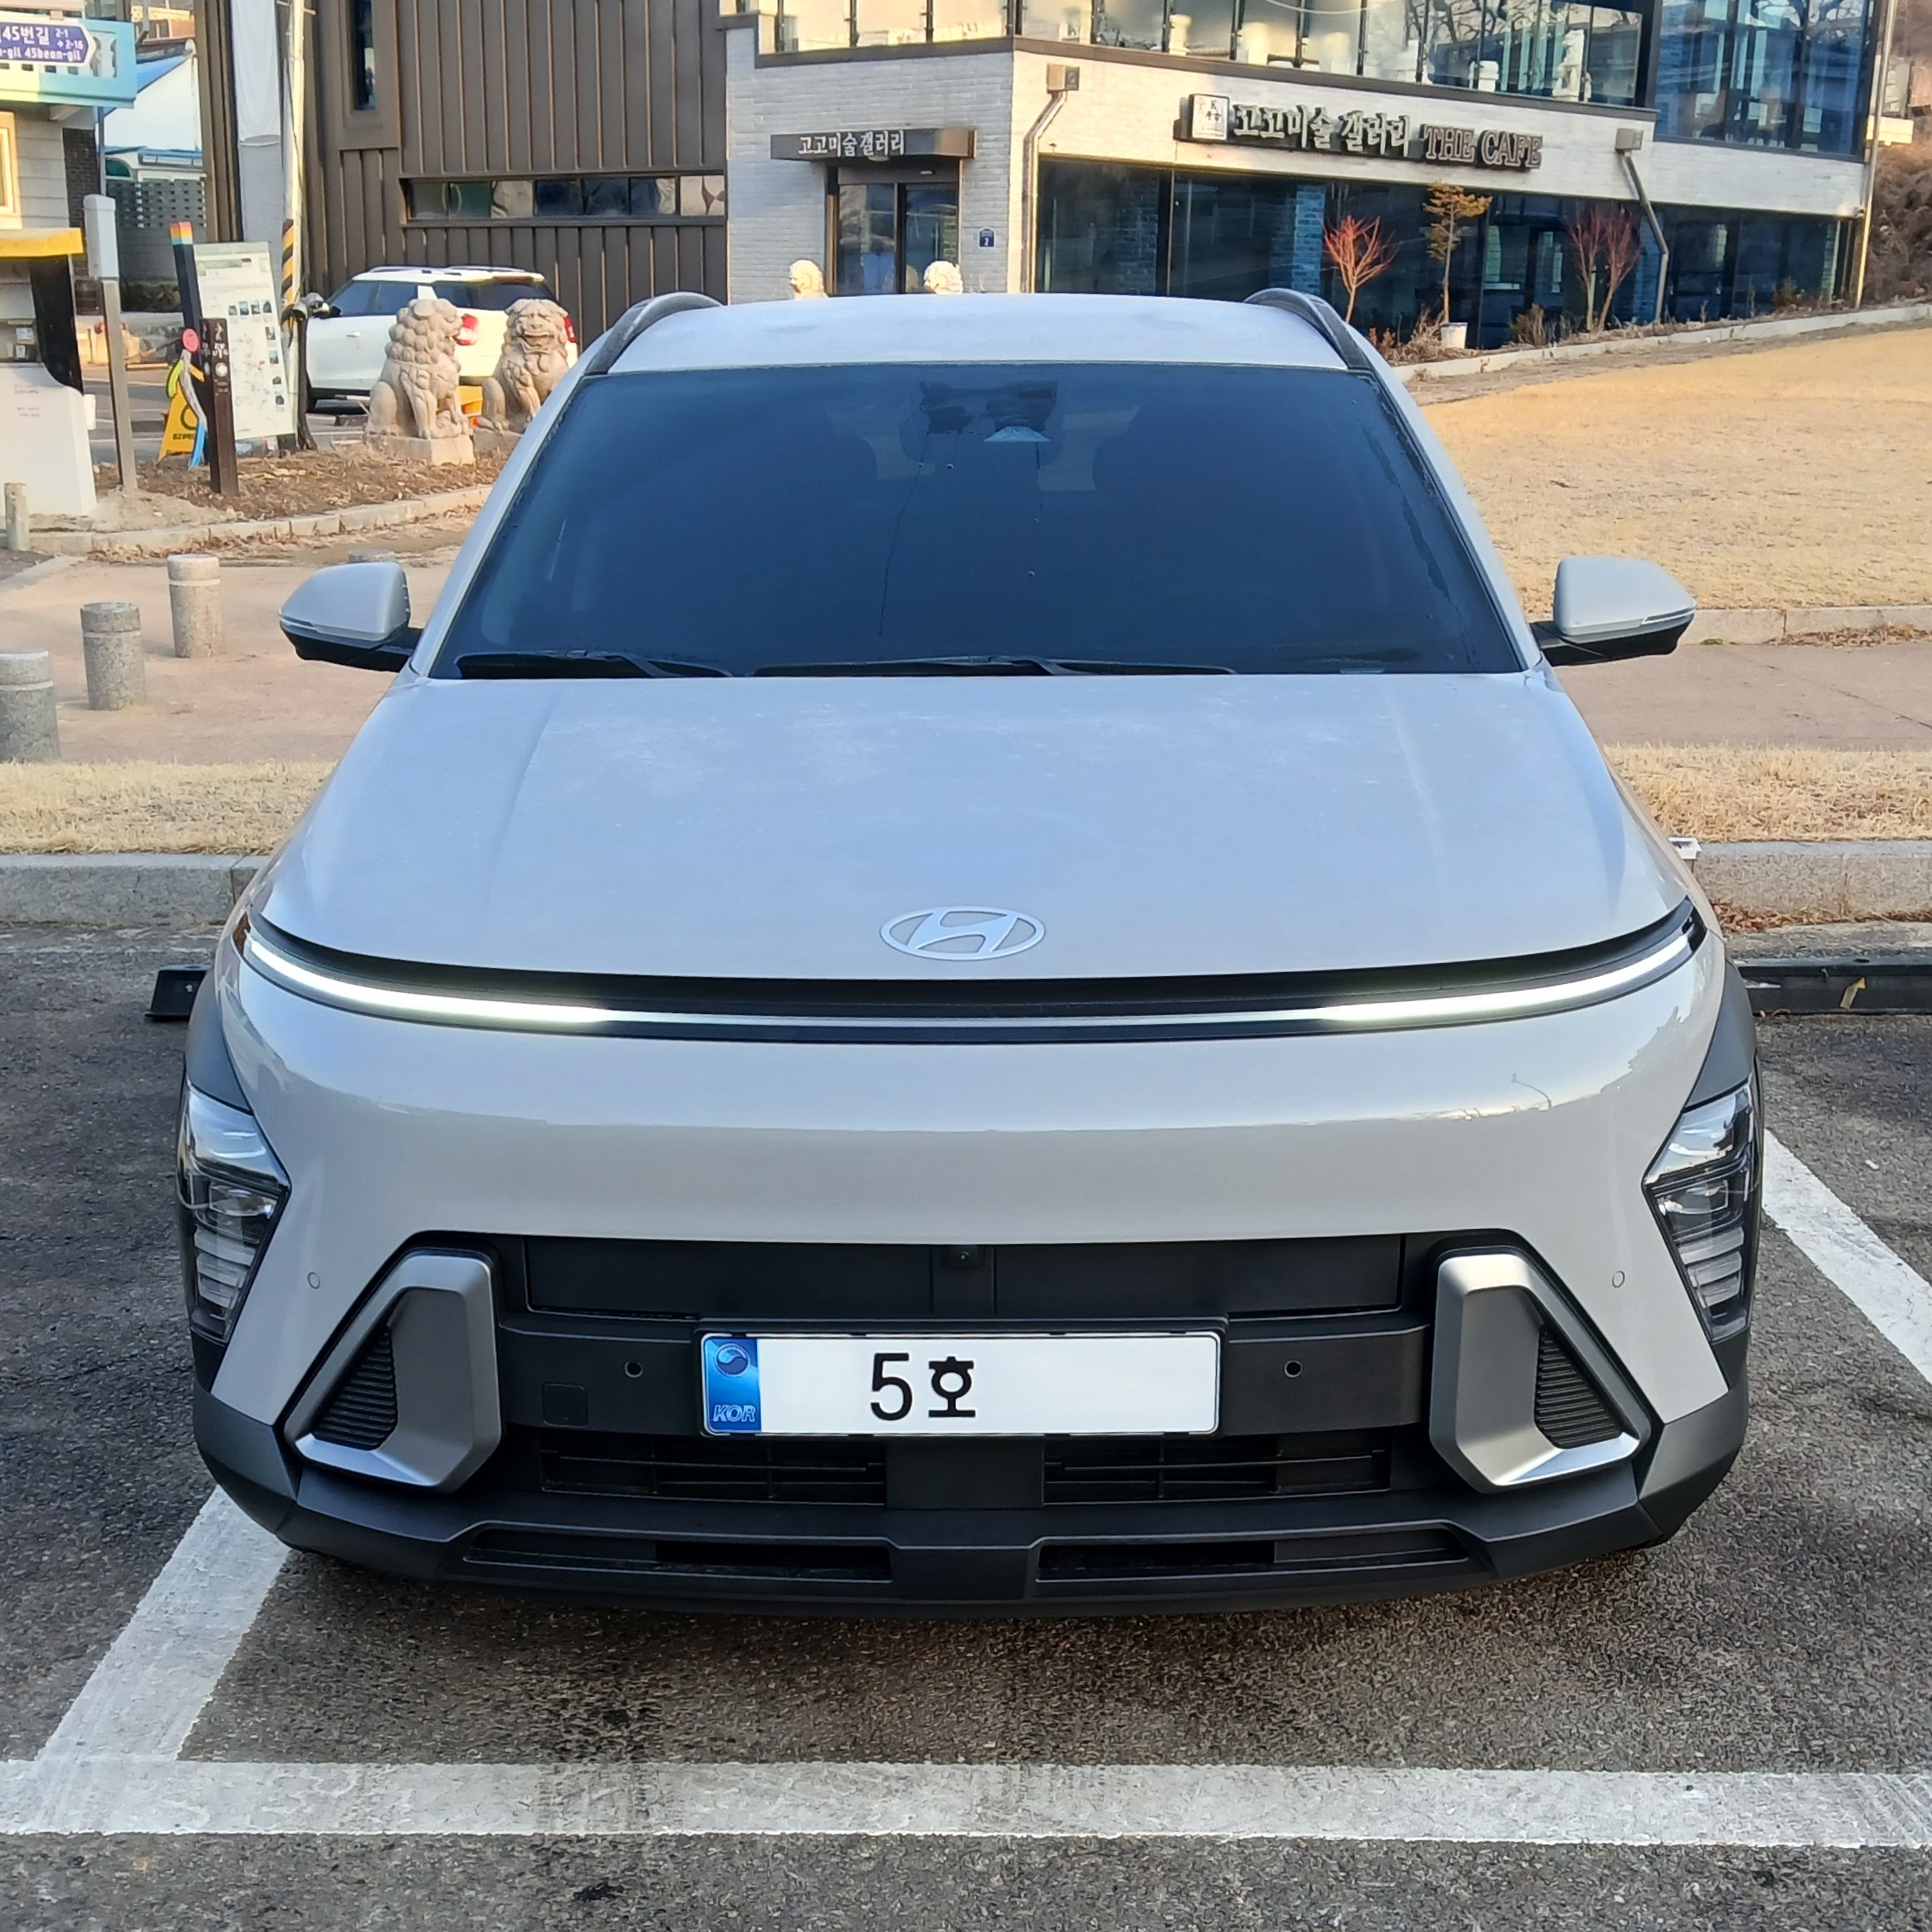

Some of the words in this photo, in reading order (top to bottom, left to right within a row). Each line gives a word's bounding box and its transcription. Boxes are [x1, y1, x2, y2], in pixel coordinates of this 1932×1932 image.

[0, 26, 49, 45] 45번길
[1422, 125, 1474, 163] THE
[1479, 130, 1543, 169] CAFE
[712, 1405, 756, 1423] KOR
